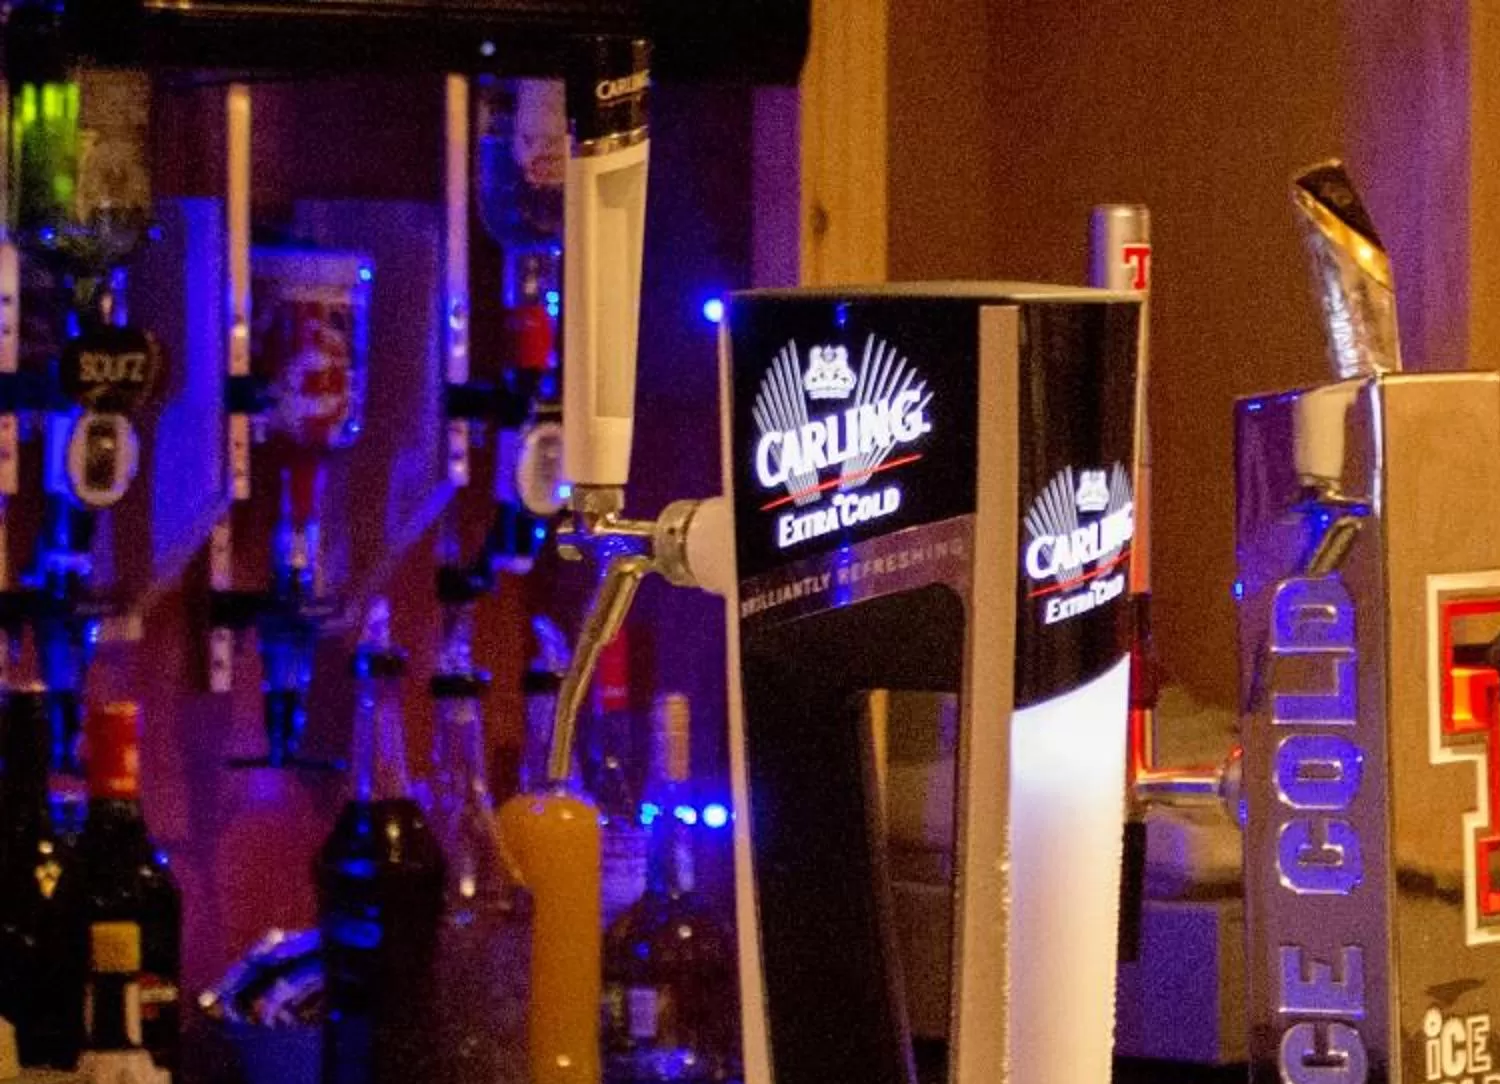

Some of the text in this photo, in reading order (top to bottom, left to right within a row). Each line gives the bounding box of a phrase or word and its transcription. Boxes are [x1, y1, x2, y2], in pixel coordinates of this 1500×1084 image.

[1122, 243, 1151, 291] T
[756, 389, 932, 488] CARLING
[837, 536, 965, 584] REFRESHING
[1269, 574, 1366, 896] COLD
